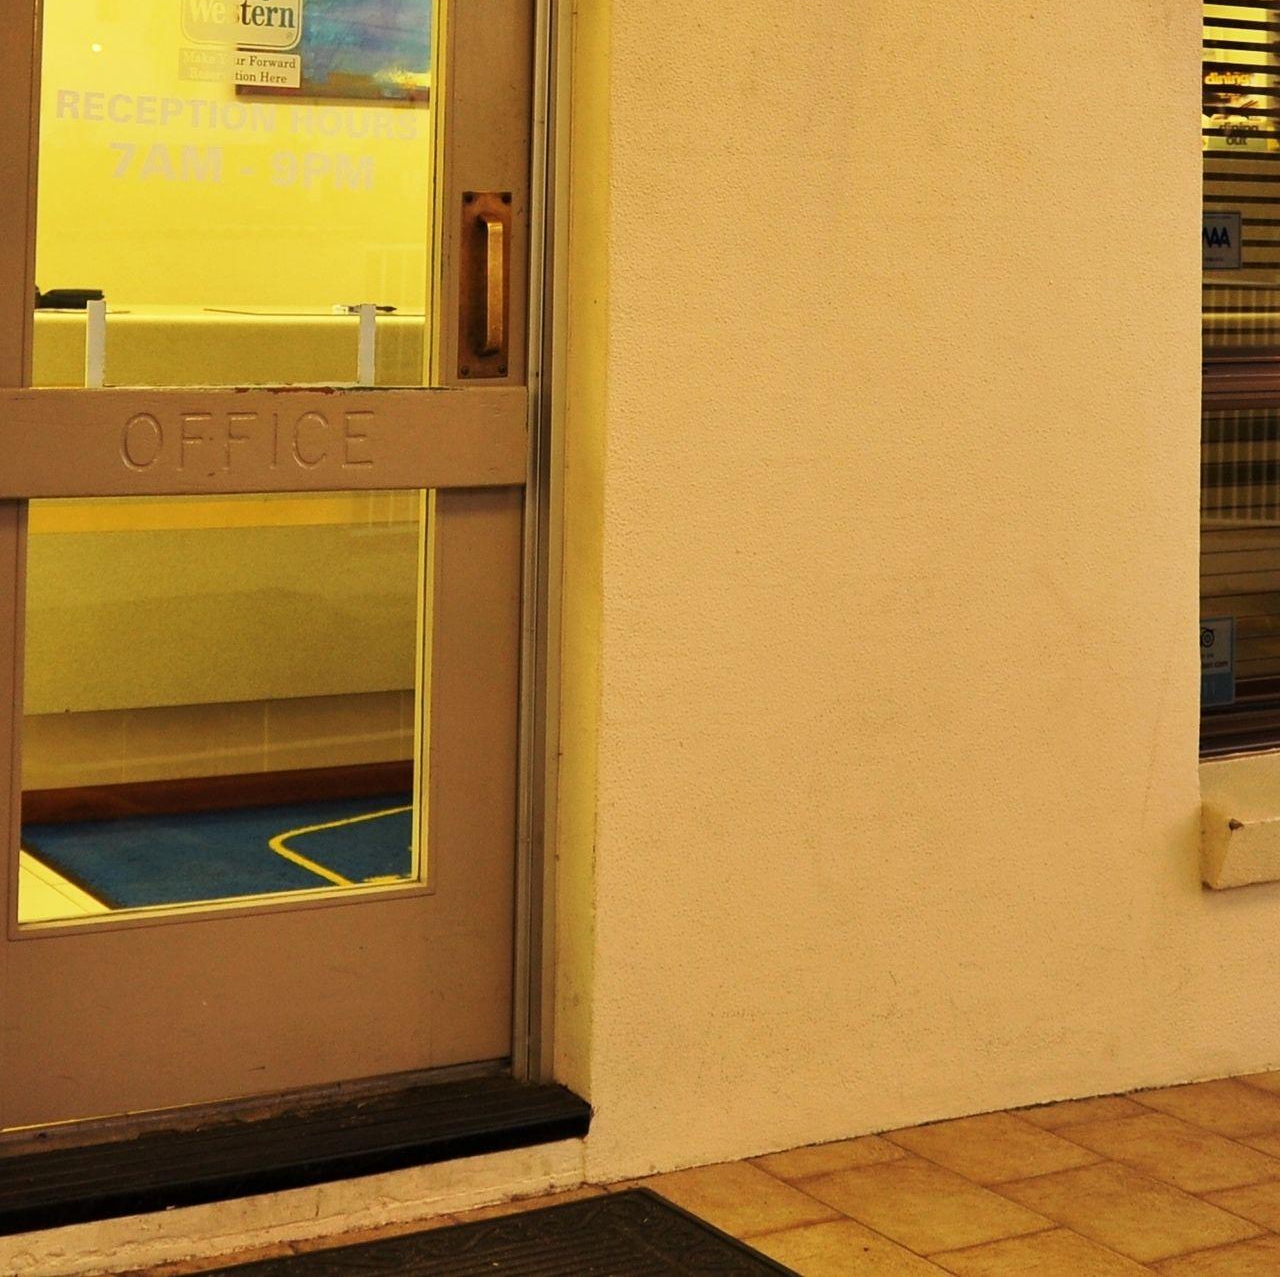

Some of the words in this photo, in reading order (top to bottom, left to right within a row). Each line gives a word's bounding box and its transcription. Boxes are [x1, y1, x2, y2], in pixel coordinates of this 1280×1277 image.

[249, 56, 297, 69] Forward
[260, 72, 287, 84] Here
[55, 89, 277, 132] RECEPTION
[289, 110, 418, 140] HOURS
[110, 142, 222, 184] 7AM
[272, 150, 376, 191] 9PM
[119, 411, 375, 472] OFFICE
